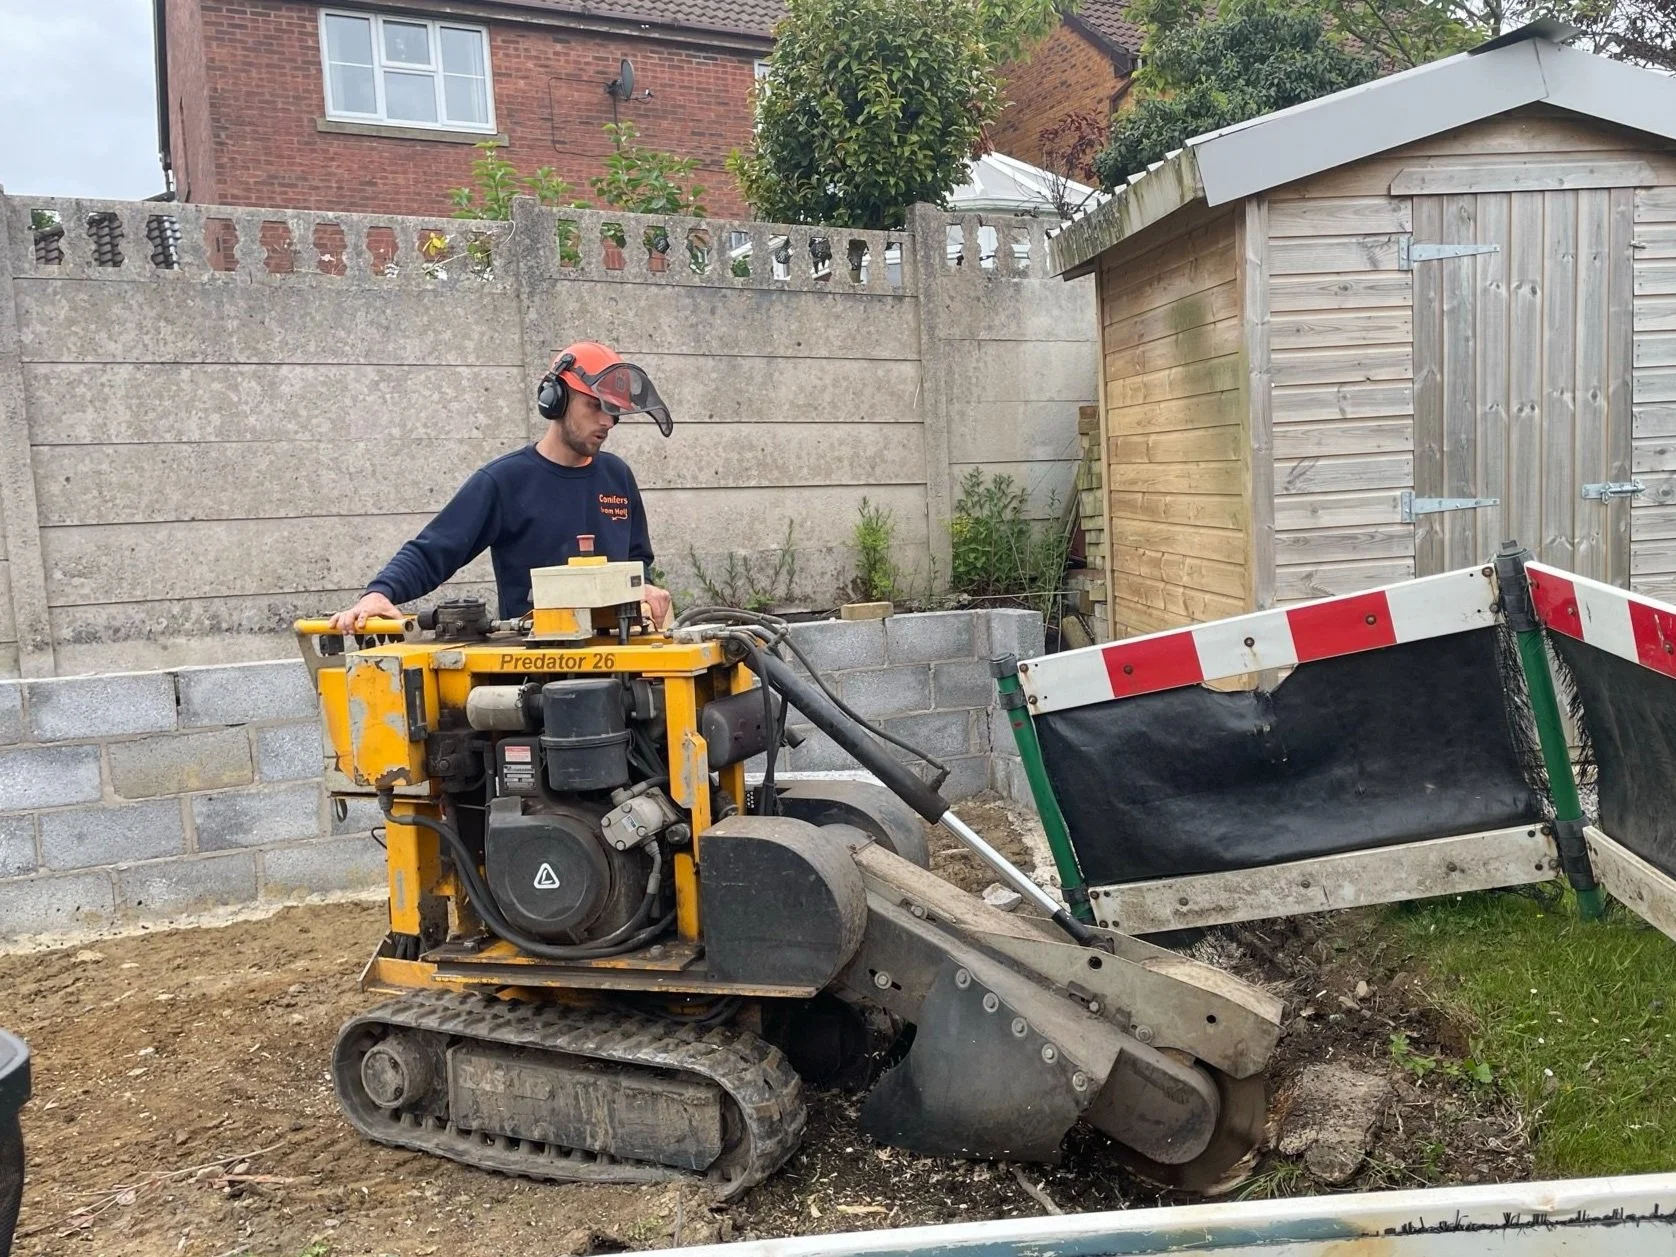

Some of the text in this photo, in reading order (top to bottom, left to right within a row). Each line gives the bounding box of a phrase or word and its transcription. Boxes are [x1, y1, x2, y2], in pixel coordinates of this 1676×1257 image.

[599, 494, 628, 504] Conifers
[614, 508, 628, 518] Hell
[500, 652, 615, 670] Predator 26
